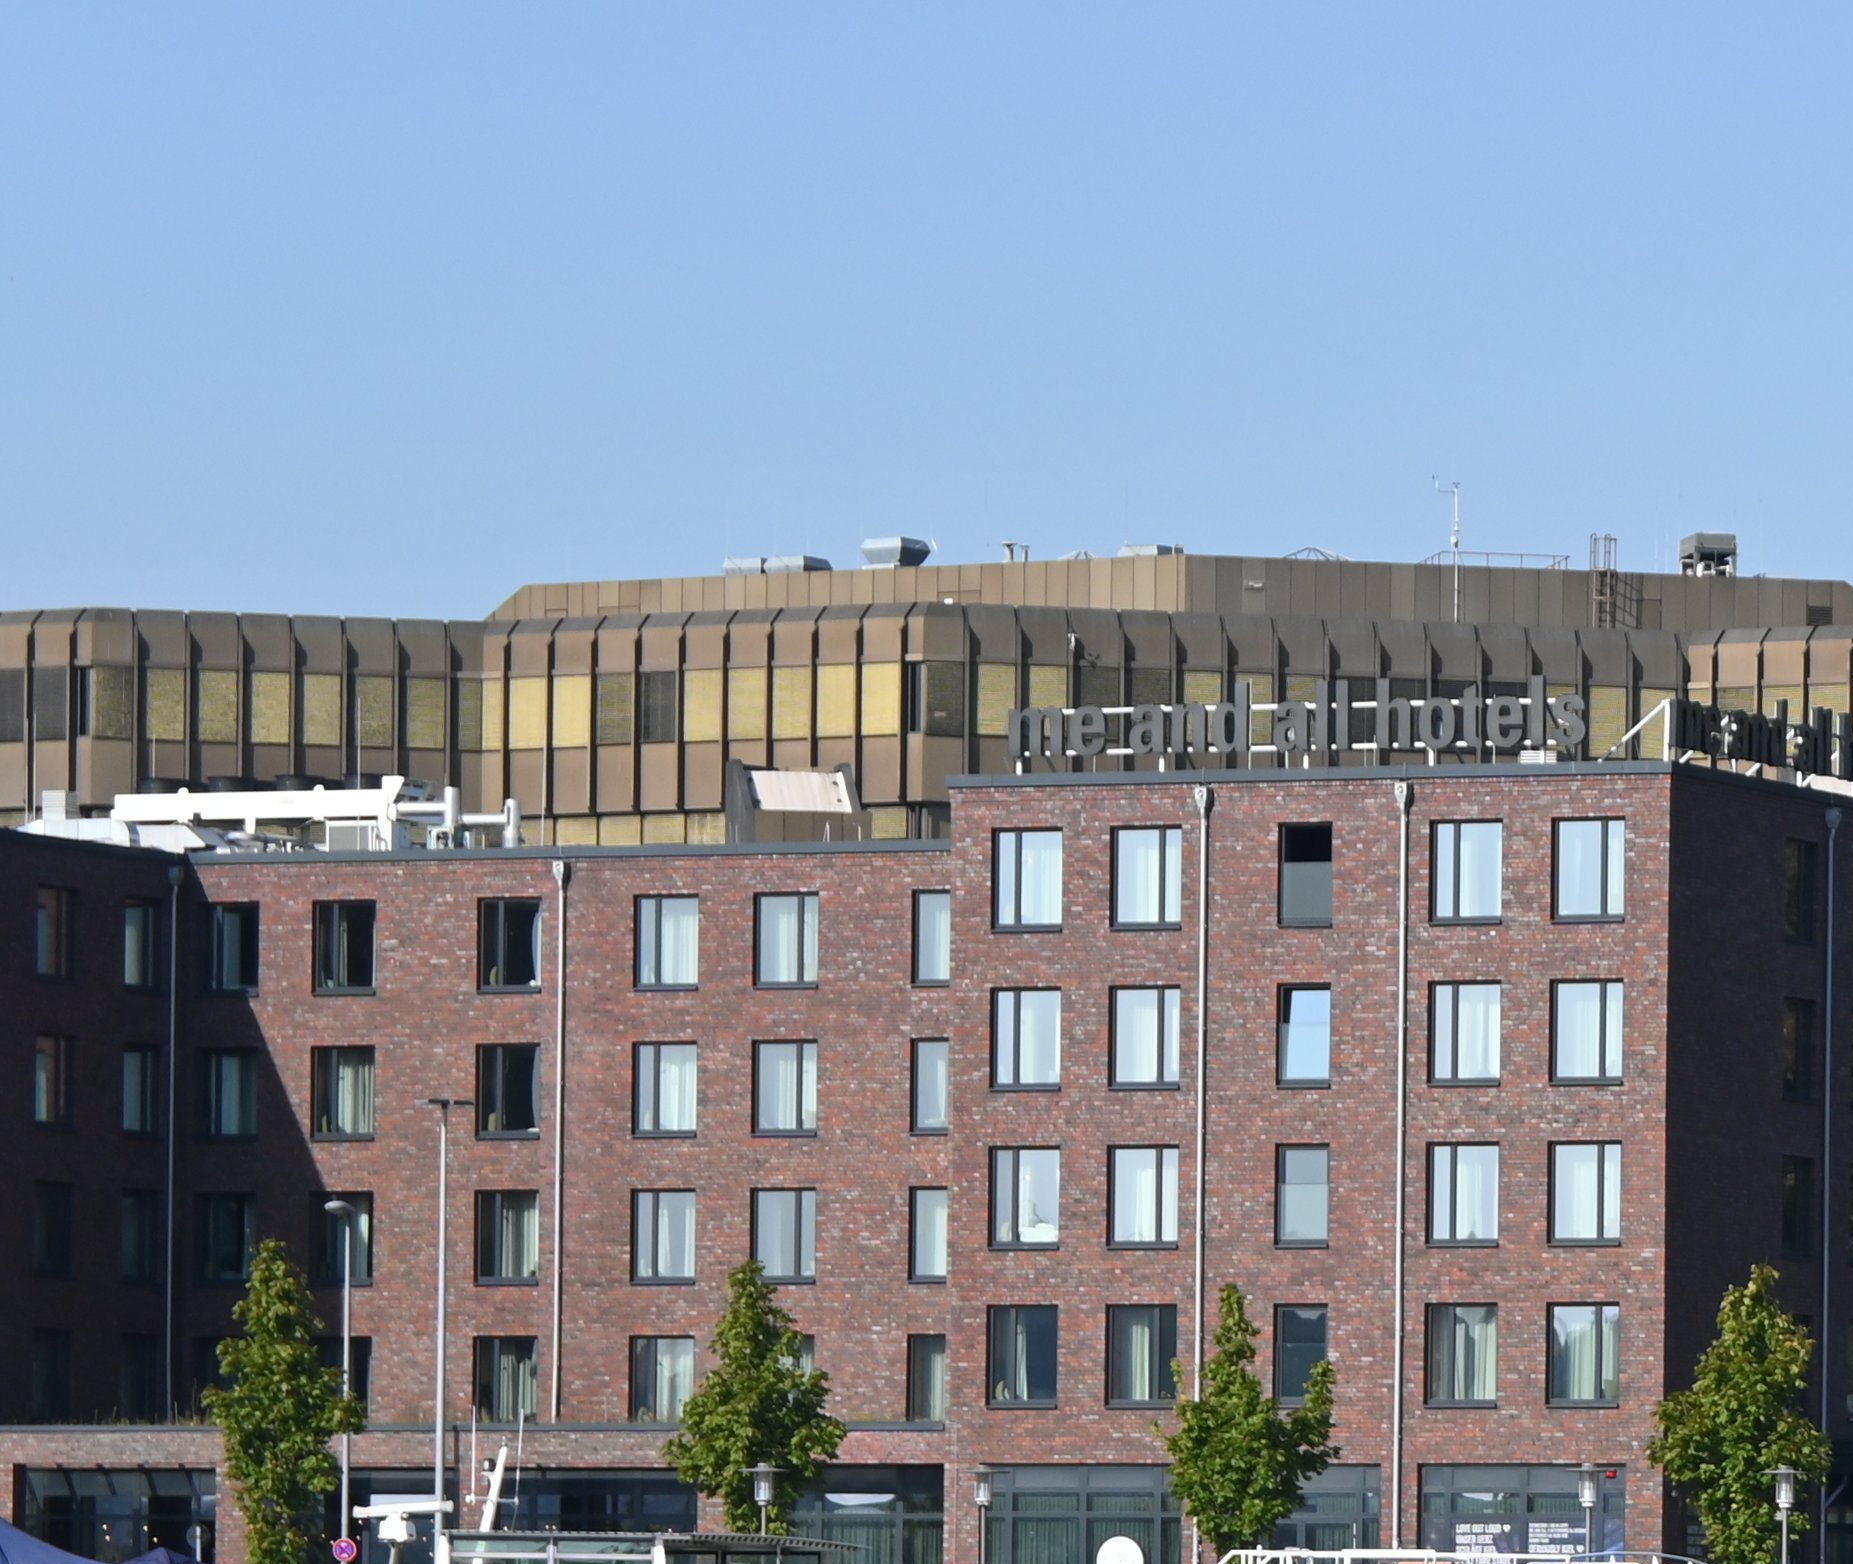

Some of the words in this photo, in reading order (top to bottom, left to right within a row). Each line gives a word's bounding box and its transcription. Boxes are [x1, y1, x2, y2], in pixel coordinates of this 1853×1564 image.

[1008, 704, 1106, 757] me
[1129, 681, 1250, 755] and
[1273, 678, 1349, 751] all
[1376, 674, 1587, 750] hotels
[1669, 699, 1722, 755] me
[1726, 698, 1788, 768] and
[1792, 706, 1834, 776] all
